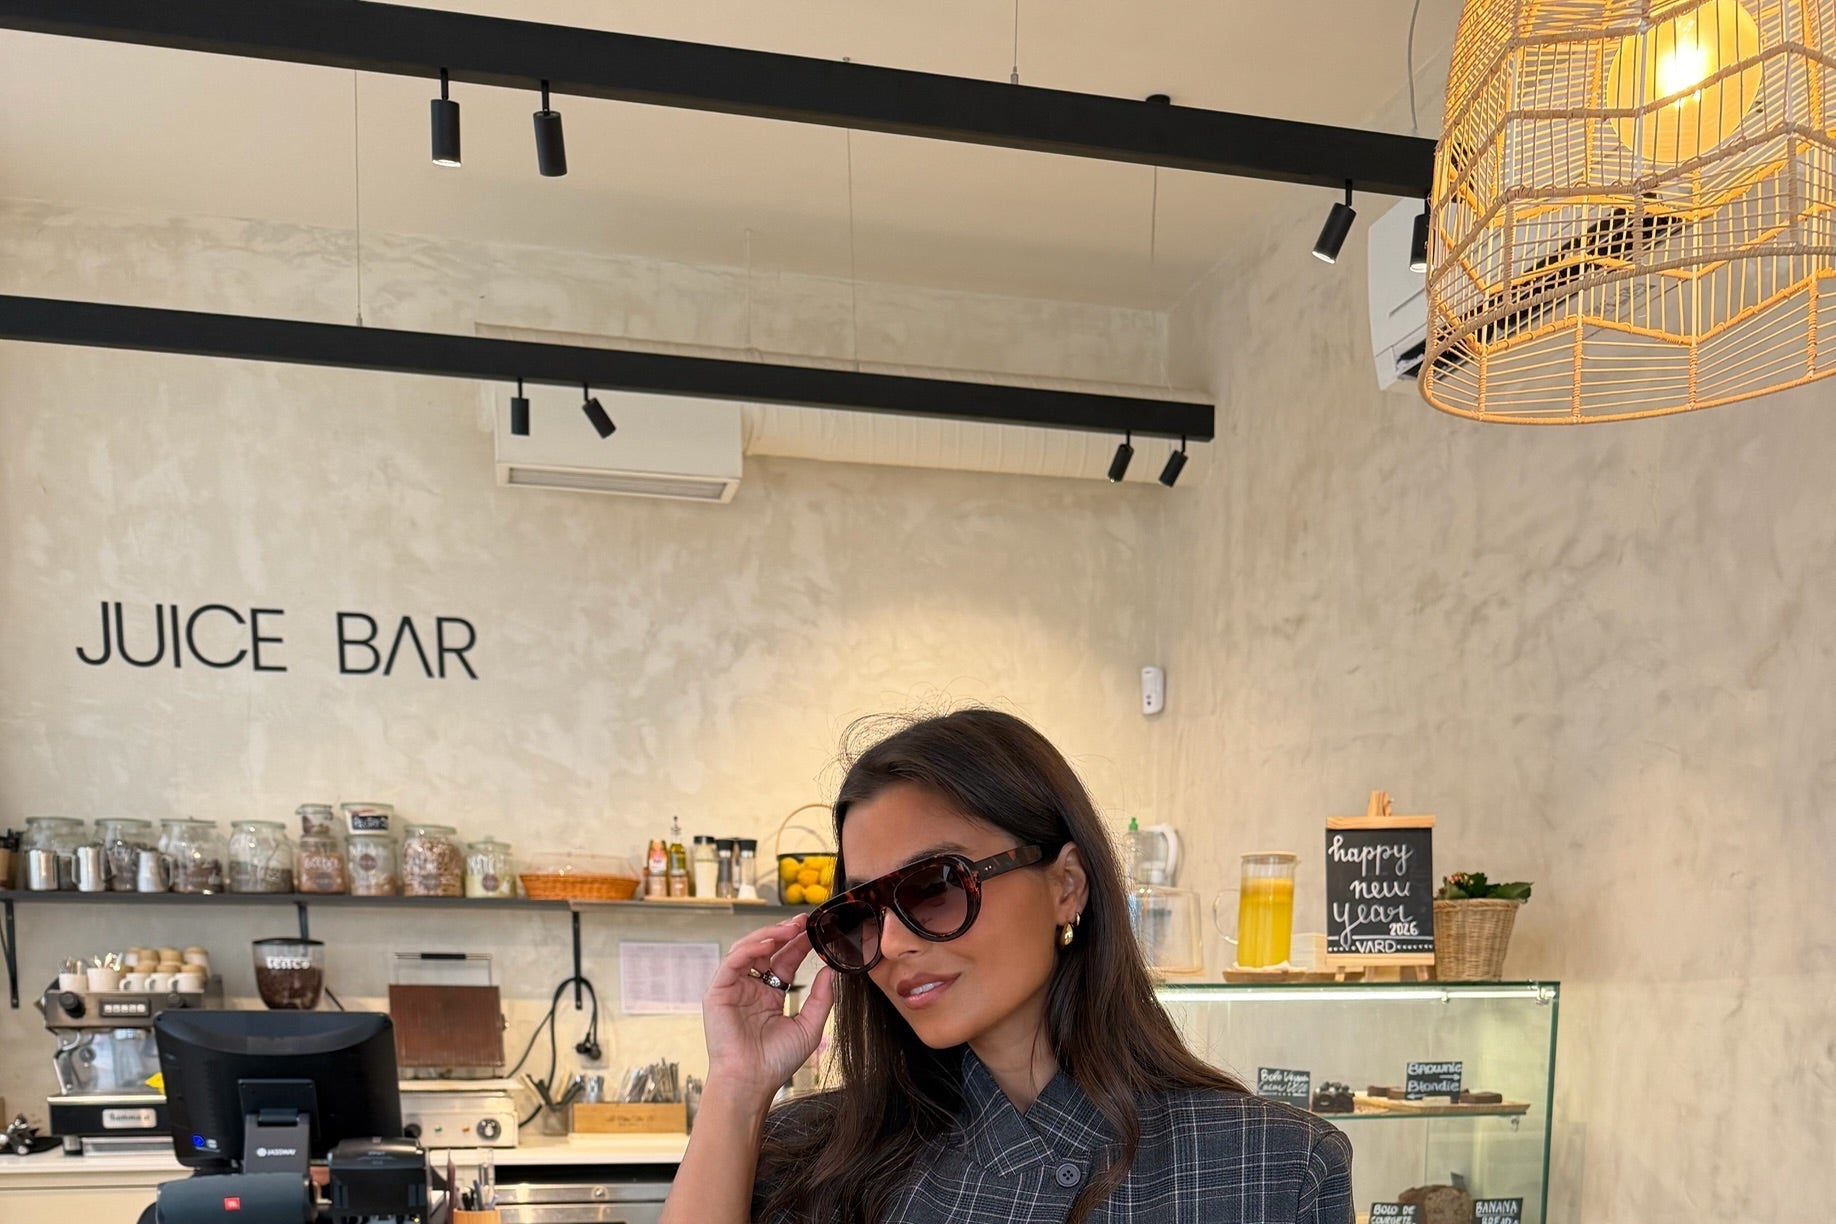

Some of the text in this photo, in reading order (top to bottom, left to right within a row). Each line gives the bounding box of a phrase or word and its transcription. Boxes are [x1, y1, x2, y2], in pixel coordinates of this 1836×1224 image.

[76, 601, 478, 680] JUICE BAR
[1328, 834, 1414, 877] happy
[1350, 880, 1411, 900] new
[1333, 901, 1414, 951] year
[1389, 921, 1419, 936] 2026
[1355, 940, 1396, 953] VARD
[1407, 1080, 1460, 1093] Blondie
[1373, 1203, 1417, 1216] BOLO DE
[1475, 1200, 1518, 1218] BANANA
